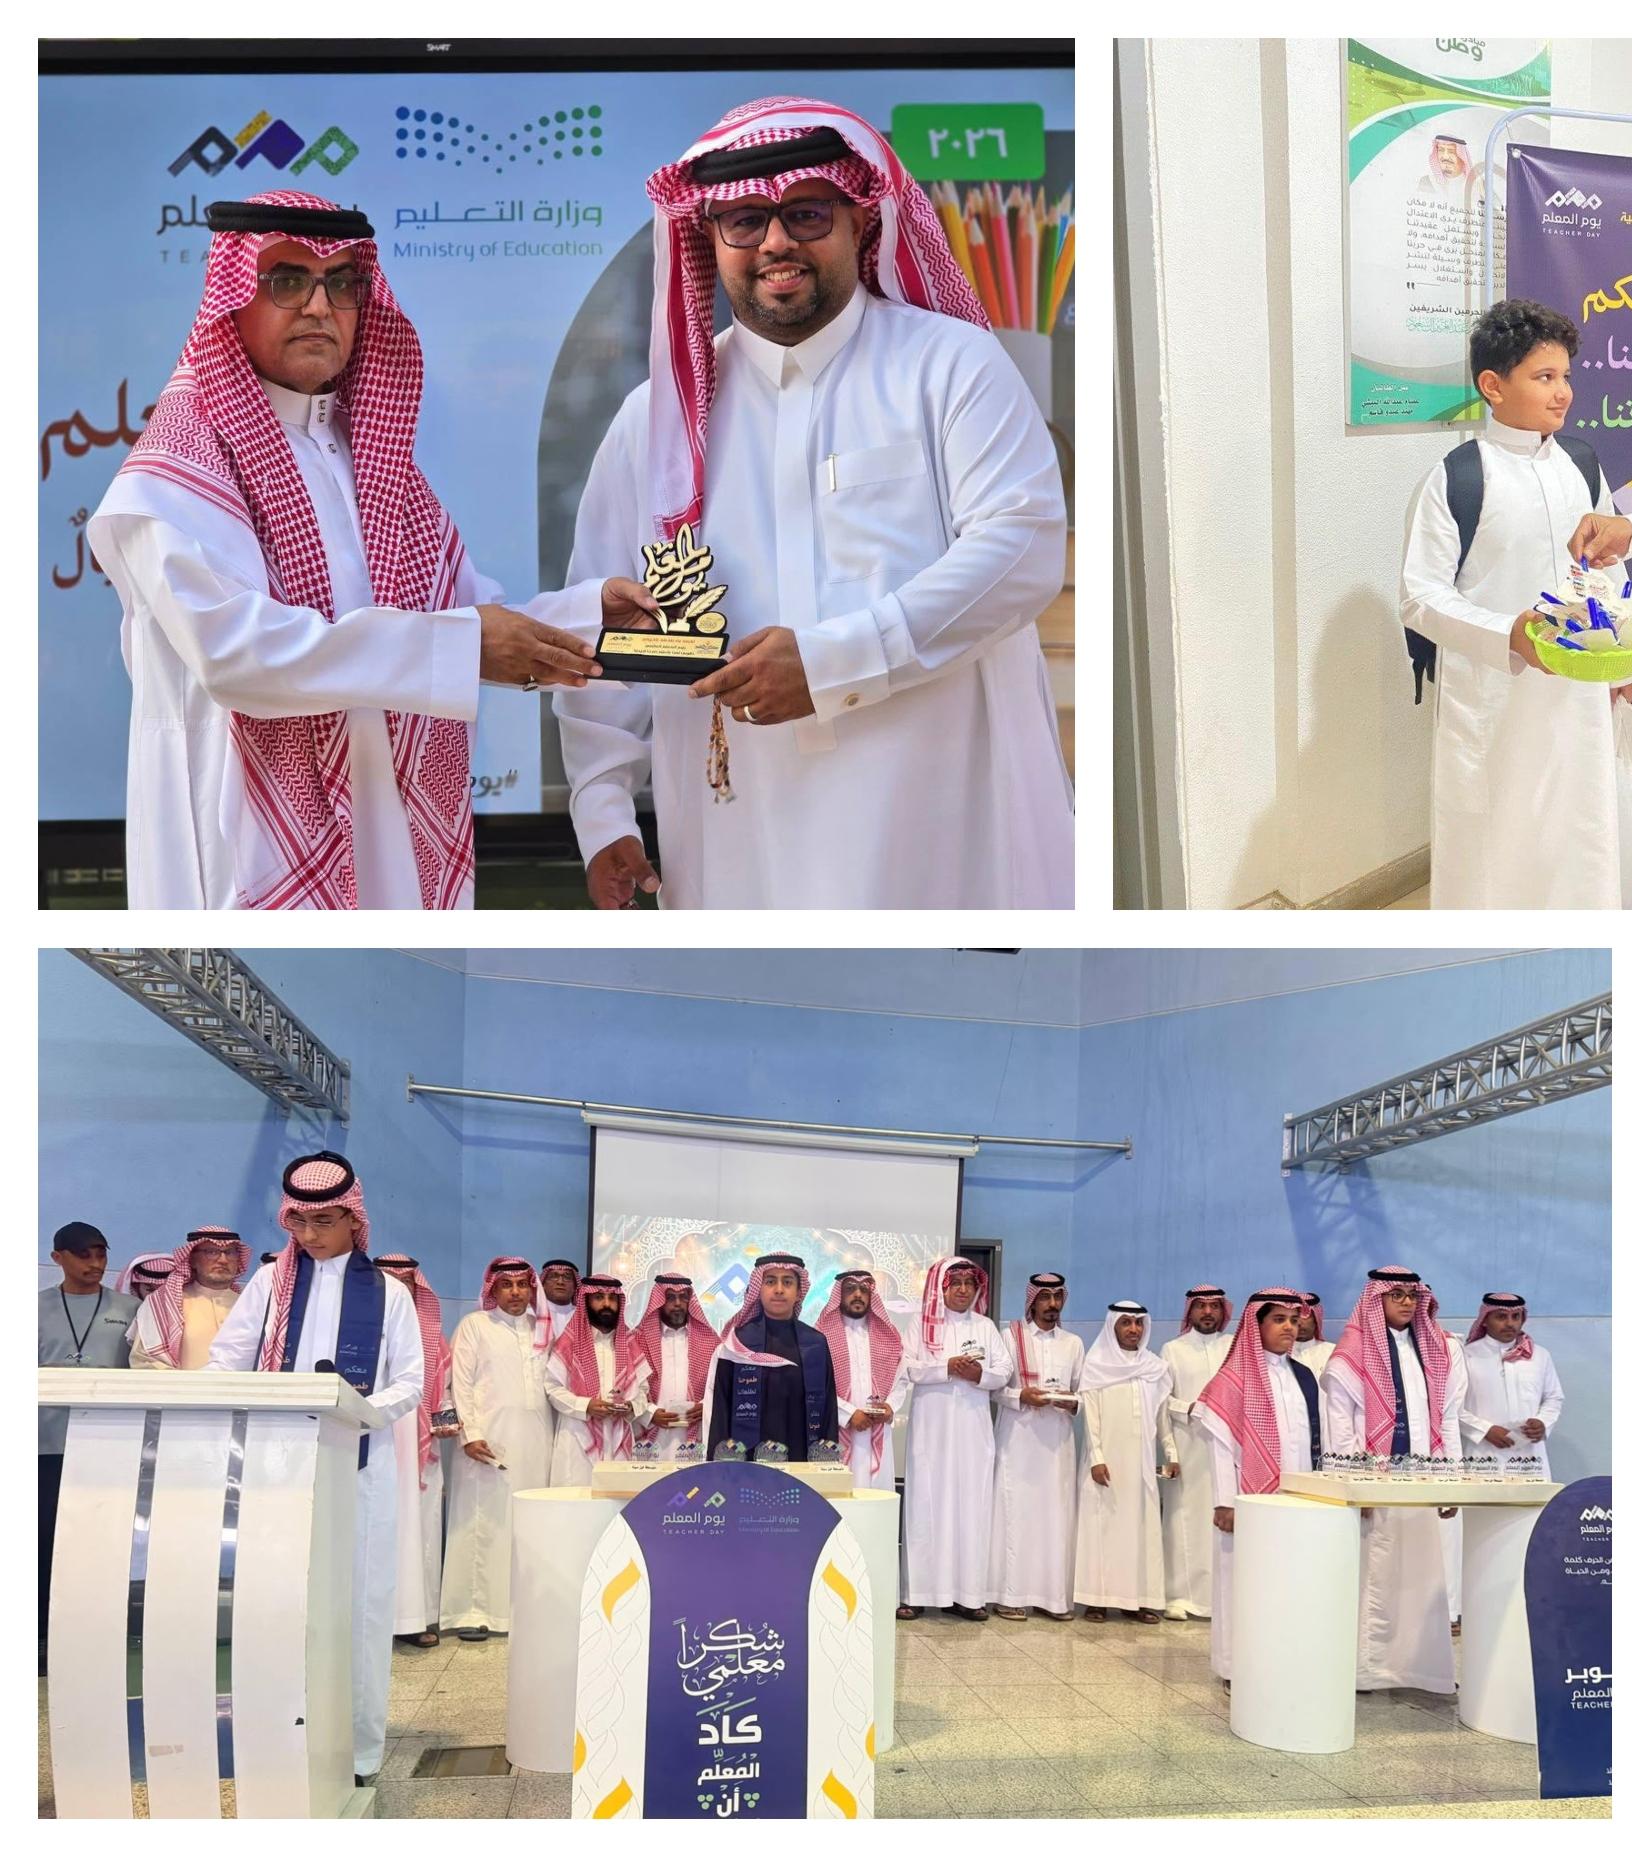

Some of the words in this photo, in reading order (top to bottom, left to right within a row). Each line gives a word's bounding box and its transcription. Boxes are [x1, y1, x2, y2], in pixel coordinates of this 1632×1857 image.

[928, 128, 1008, 158] ٢٠٢٦
[394, 199, 525, 230] التعليم
[533, 201, 602, 228] وزارة
[1541, 211, 1578, 225] المعلم
[1580, 218, 1602, 230] يوم
[1542, 227, 1582, 237] TEACHER
[394, 241, 476, 262] Ministry
[479, 240, 499, 256] of
[503, 240, 602, 258] Education
[1409, 304, 1452, 313] الشريفين
[344, 1364, 368, 1375] معكم
[661, 1511, 701, 1526] المعلم
[703, 1514, 726, 1527] يوم
[1580, 1524, 1605, 1535] المعلم
[1583, 1556, 1604, 1564] الحرف
[1590, 1568, 1610, 1576] ومن
